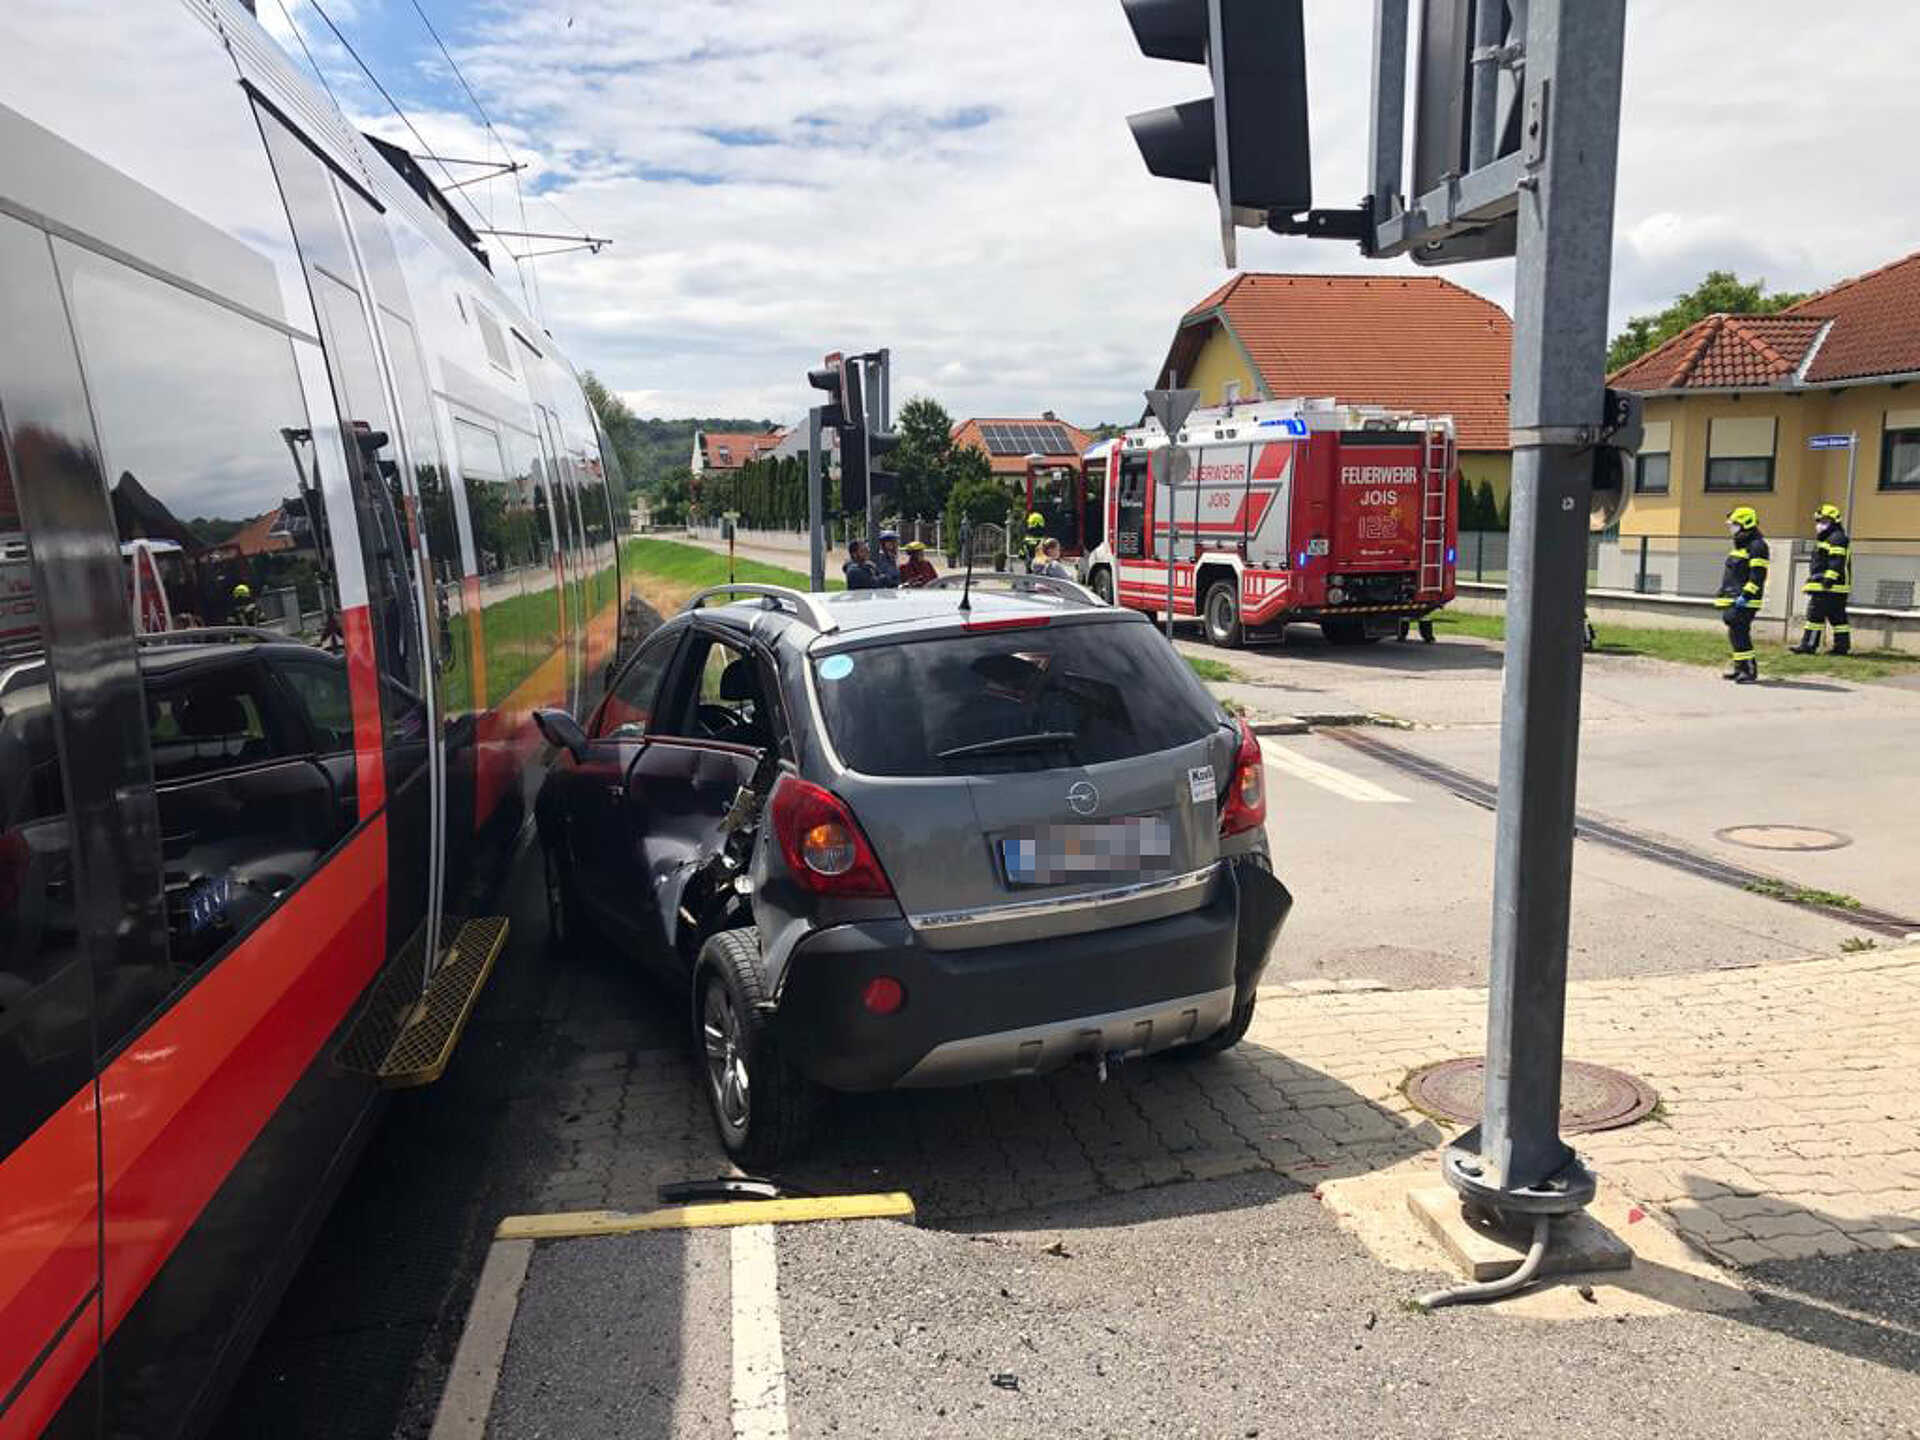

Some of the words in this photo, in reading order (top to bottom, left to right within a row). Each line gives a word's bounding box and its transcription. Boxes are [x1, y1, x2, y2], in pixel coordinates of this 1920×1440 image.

[1186, 465, 1245, 481] EUERWEHR
[1341, 466, 1417, 484] FEUERWEHR
[1360, 489, 1398, 506] JOIS
